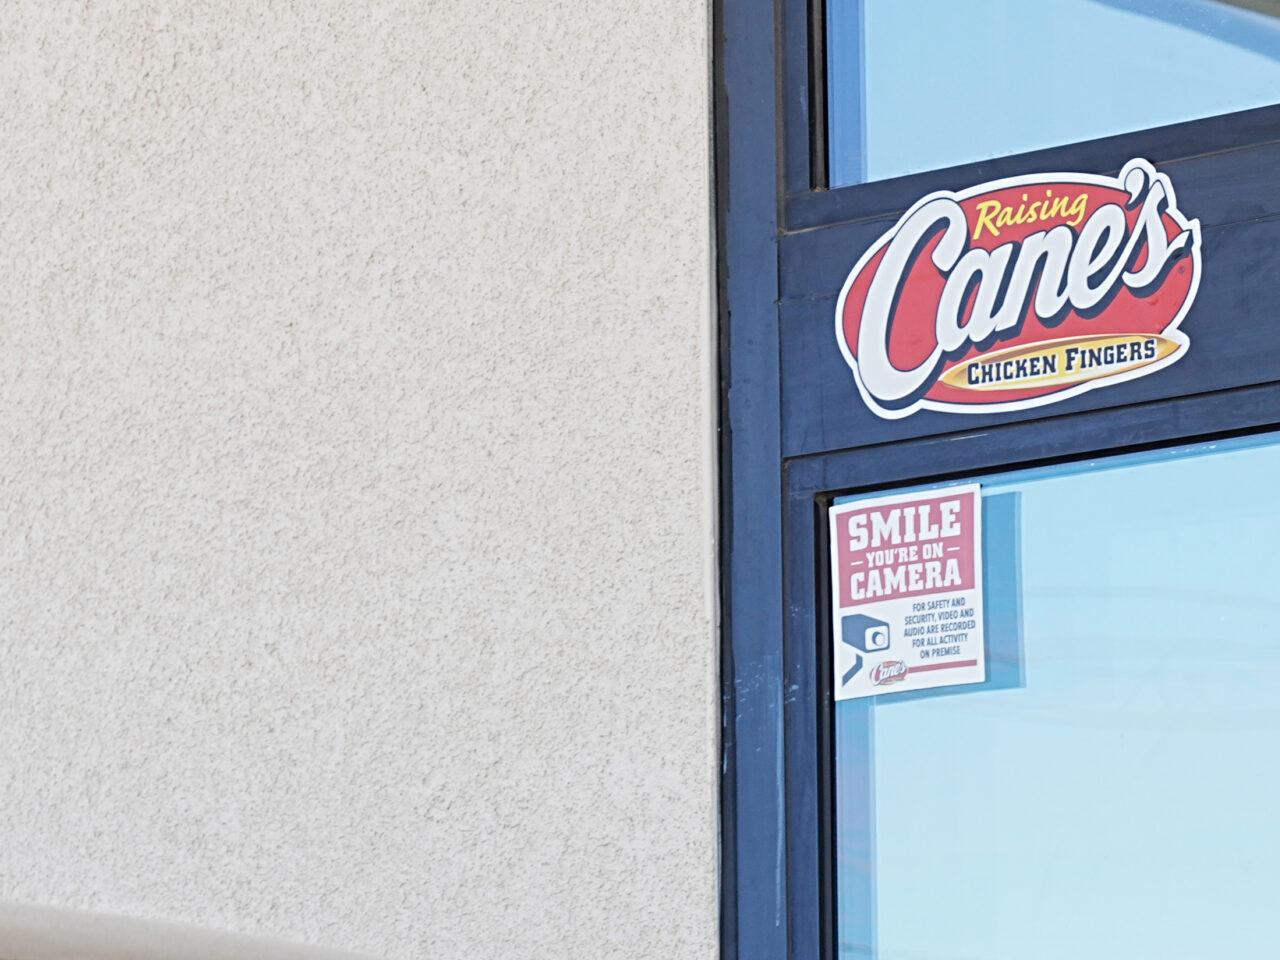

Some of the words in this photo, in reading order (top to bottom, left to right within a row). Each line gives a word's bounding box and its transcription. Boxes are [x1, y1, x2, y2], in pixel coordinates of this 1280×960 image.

[972, 190, 1089, 241] Raising
[857, 168, 1191, 401] Cane's
[967, 354, 1056, 385] CHICKEN
[1065, 339, 1156, 371] FINGERS
[848, 500, 962, 552] SMILE
[866, 545, 918, 568] YOU'RE
[922, 542, 944, 559] ON
[850, 558, 962, 600] CAMERA
[904, 613, 937, 626] SECURITY,
[938, 610, 959, 621] VIDEO
[960, 608, 975, 618] AND
[912, 602, 926, 612] FOR
[927, 599, 950, 610] SAFETY
[951, 597, 966, 607] AND
[904, 626, 925, 637] AUDIO
[926, 624, 940, 634] ARE
[940, 620, 976, 633] RECORDED
[912, 638, 925, 648] FOR
[926, 637, 938, 646] ALL
[939, 633, 969, 644] ACTIVITY
[920, 650, 930, 659] ON
[932, 646, 960, 657] PREMISE
